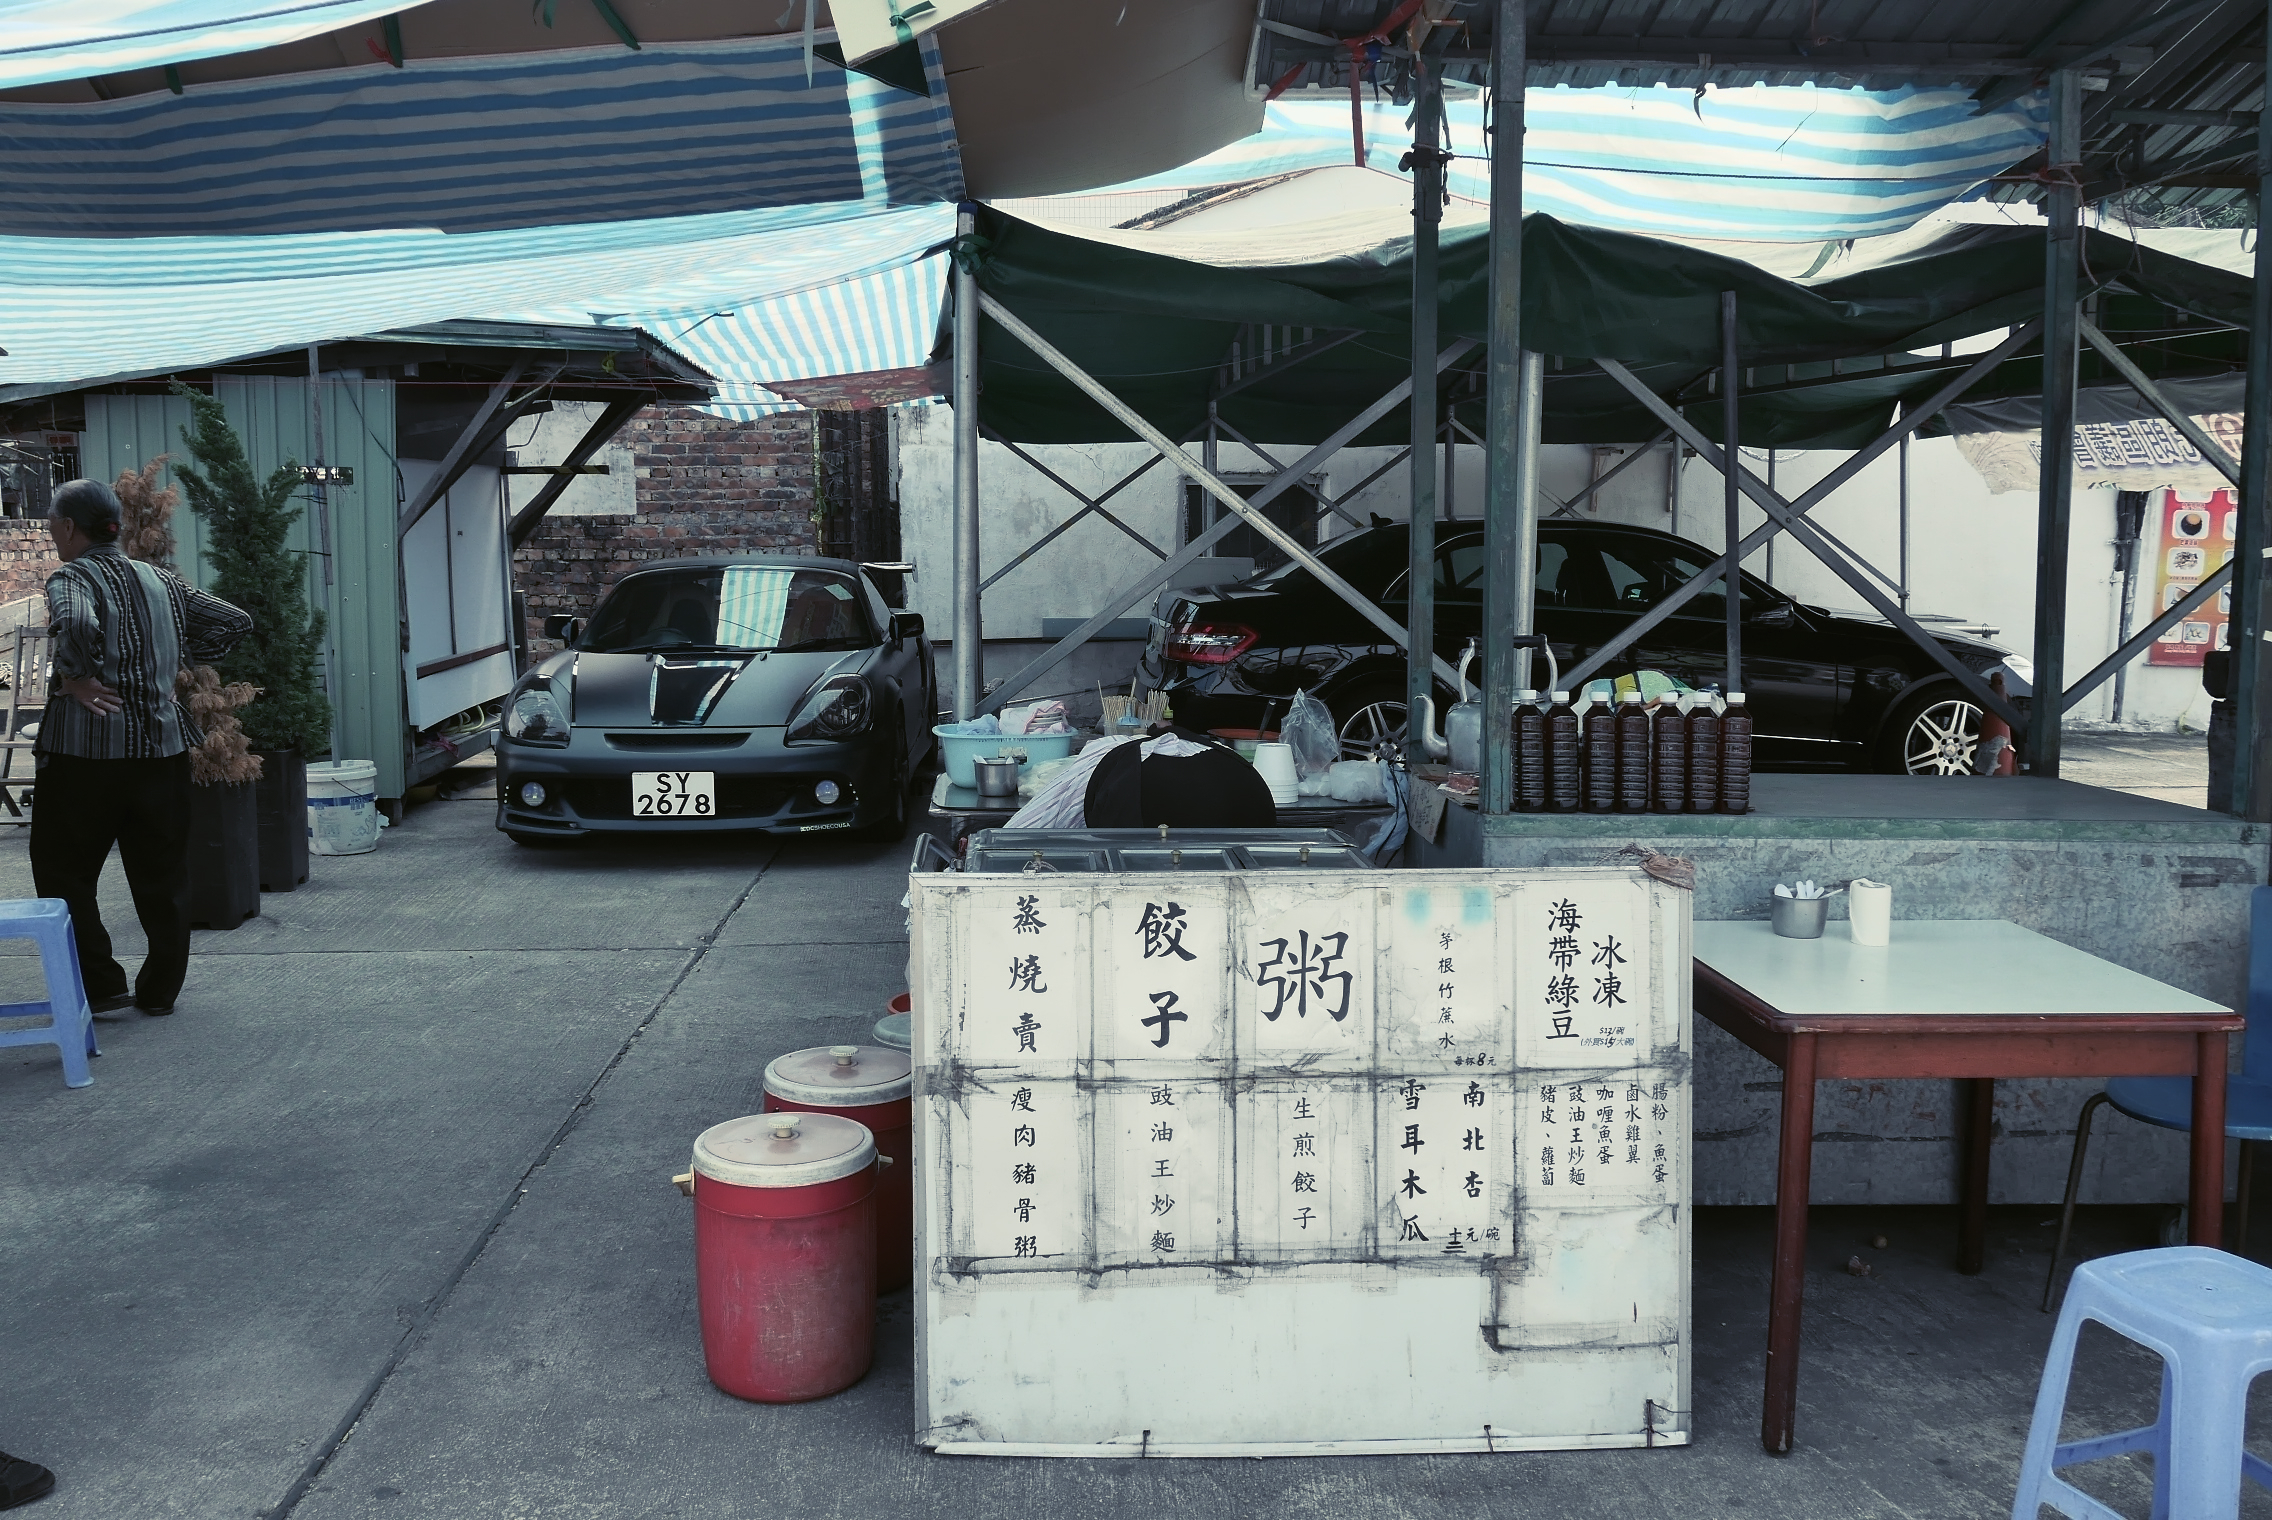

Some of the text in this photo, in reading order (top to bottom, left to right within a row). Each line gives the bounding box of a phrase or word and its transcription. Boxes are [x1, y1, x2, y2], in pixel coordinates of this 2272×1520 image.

[638, 794, 711, 815] 2678
[656, 773, 690, 793] SY
[1008, 895, 1048, 1053] 蒸燒賣
[1134, 901, 1198, 1048] 餃子
[1257, 929, 1353, 1022] 粥
[1438, 932, 1456, 1050] 茅根竹蔗水
[1544, 897, 1584, 1040] 海帶綠豆
[1590, 934, 1628, 1009] 冰凍
[1453, 1052, 1497, 1067] 每杯8元
[1010, 1086, 1037, 1258] 瘦肉豬骨粥
[1150, 1084, 1176, 1252] 豉油王炒麵
[1291, 1097, 1318, 1230] 生煎餃子
[1399, 1078, 1429, 1242] 雪耳木瓜
[1462, 1080, 1486, 1198] 南北杏
[1540, 1085, 1557, 1186] 豬皮、蘿蔔
[1568, 1085, 1586, 1186] 豉油王炒麵
[1596, 1085, 1614, 1164] 咖喱魚蛋
[1625, 1083, 1642, 1164] 鹵水雞翼
[1652, 1083, 1669, 1183] 腸粉、魚蛋
